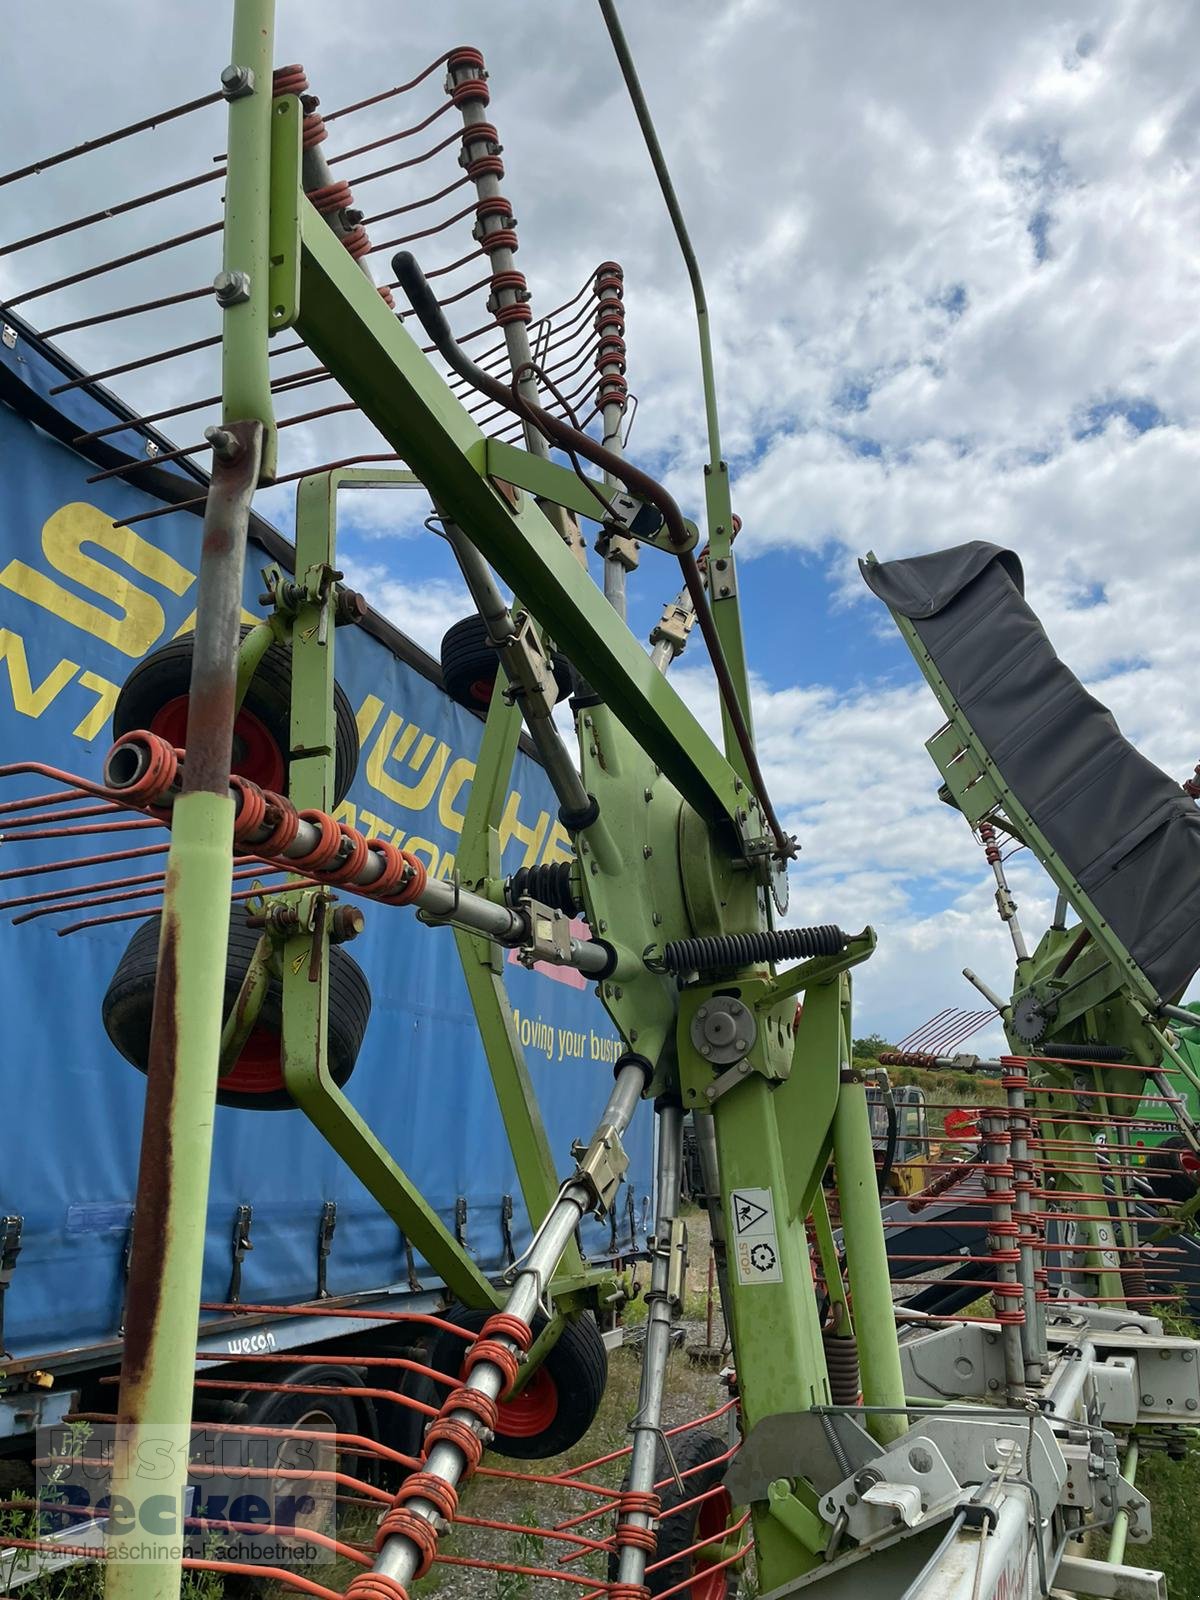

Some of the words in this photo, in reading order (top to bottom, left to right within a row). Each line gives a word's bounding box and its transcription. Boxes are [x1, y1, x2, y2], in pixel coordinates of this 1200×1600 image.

[514, 1009, 555, 1060] oving
[558, 1029, 587, 1061] your
[591, 1029, 622, 1063] busin
[738, 1241, 752, 1276] STOP
[227, 1332, 276, 1354] wecon
